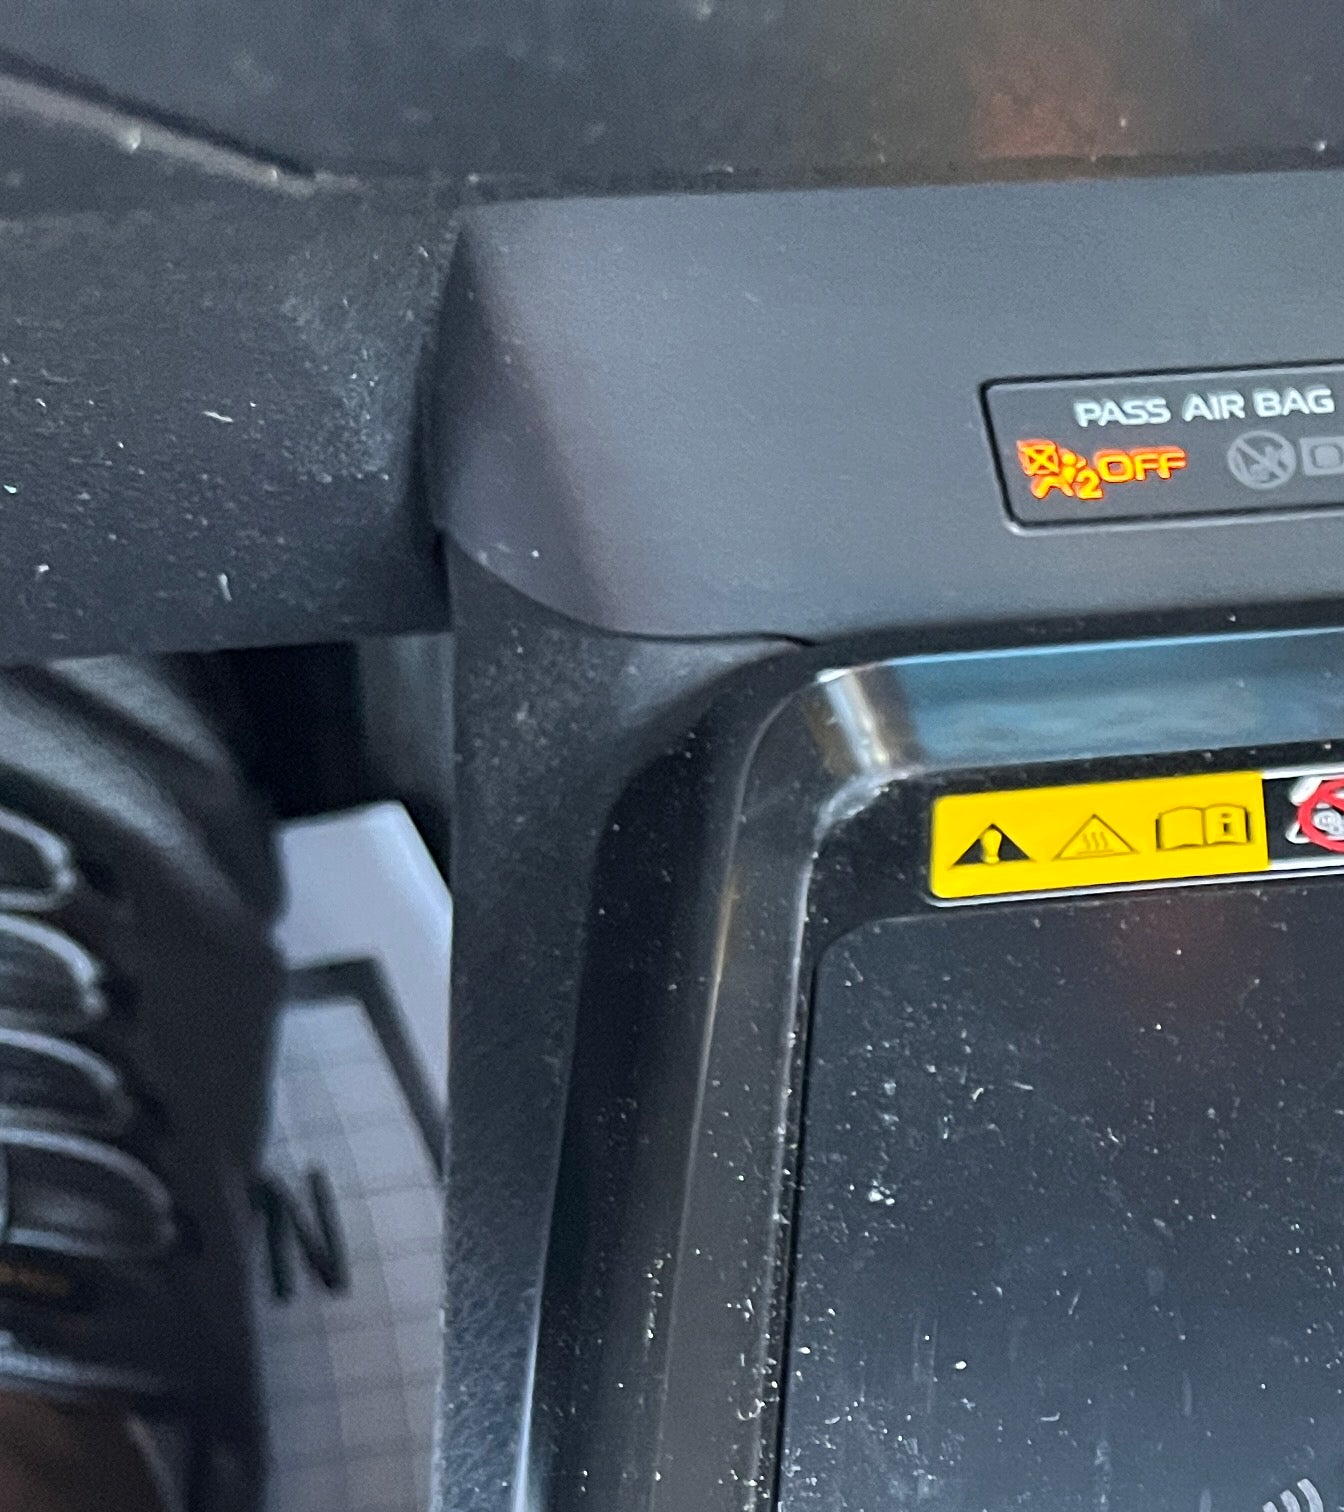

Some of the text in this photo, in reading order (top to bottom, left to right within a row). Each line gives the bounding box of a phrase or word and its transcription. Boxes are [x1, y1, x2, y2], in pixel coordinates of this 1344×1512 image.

[1074, 386, 1335, 427] PASS AIR BAG
[1094, 446, 1187, 482] OFF
